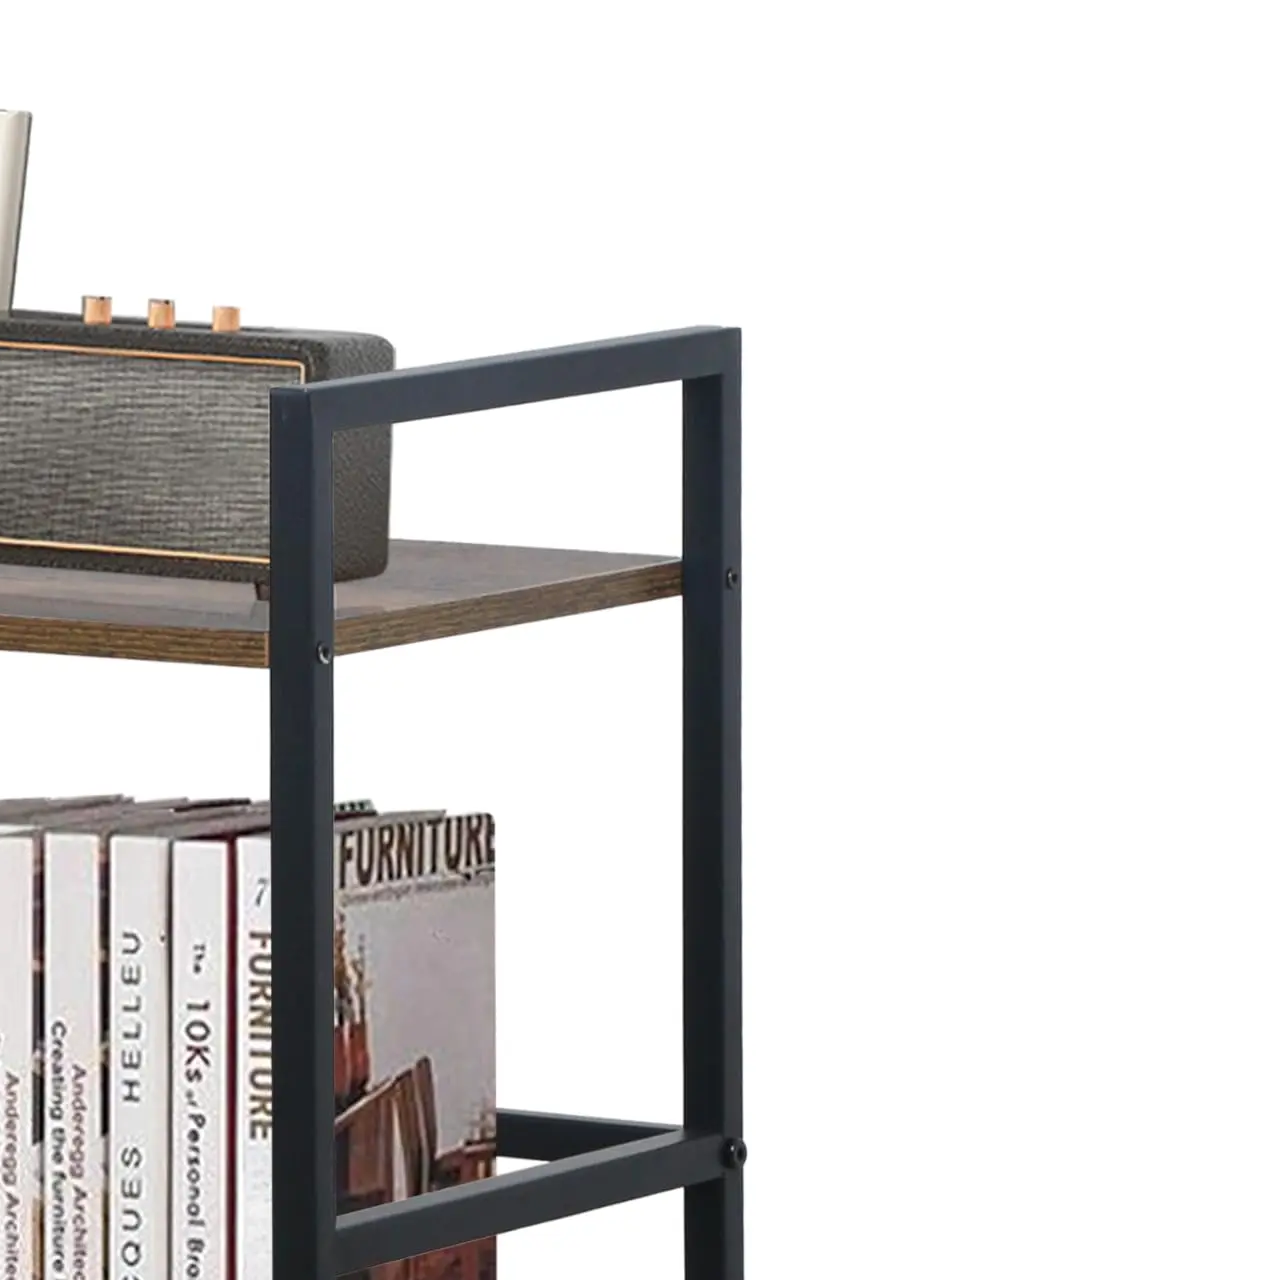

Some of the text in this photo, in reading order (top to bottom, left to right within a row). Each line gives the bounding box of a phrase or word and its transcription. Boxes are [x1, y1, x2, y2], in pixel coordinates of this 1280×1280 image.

[339, 813, 495, 889] FURNITURE
[192, 943, 207, 975] The
[122, 931, 143, 1103] HELLEU
[185, 999, 211, 1083] 10Ks
[248, 930, 272, 1141] FURNITURE
[51, 1021, 67, 1120] Creating
[70, 1065, 88, 1178] Anderegg
[3, 1072, 20, 1185] Anderegg
[52, 1128, 67, 1164] the
[186, 1112, 207, 1227] Personal
[52, 1170, 67, 1273] furniture
